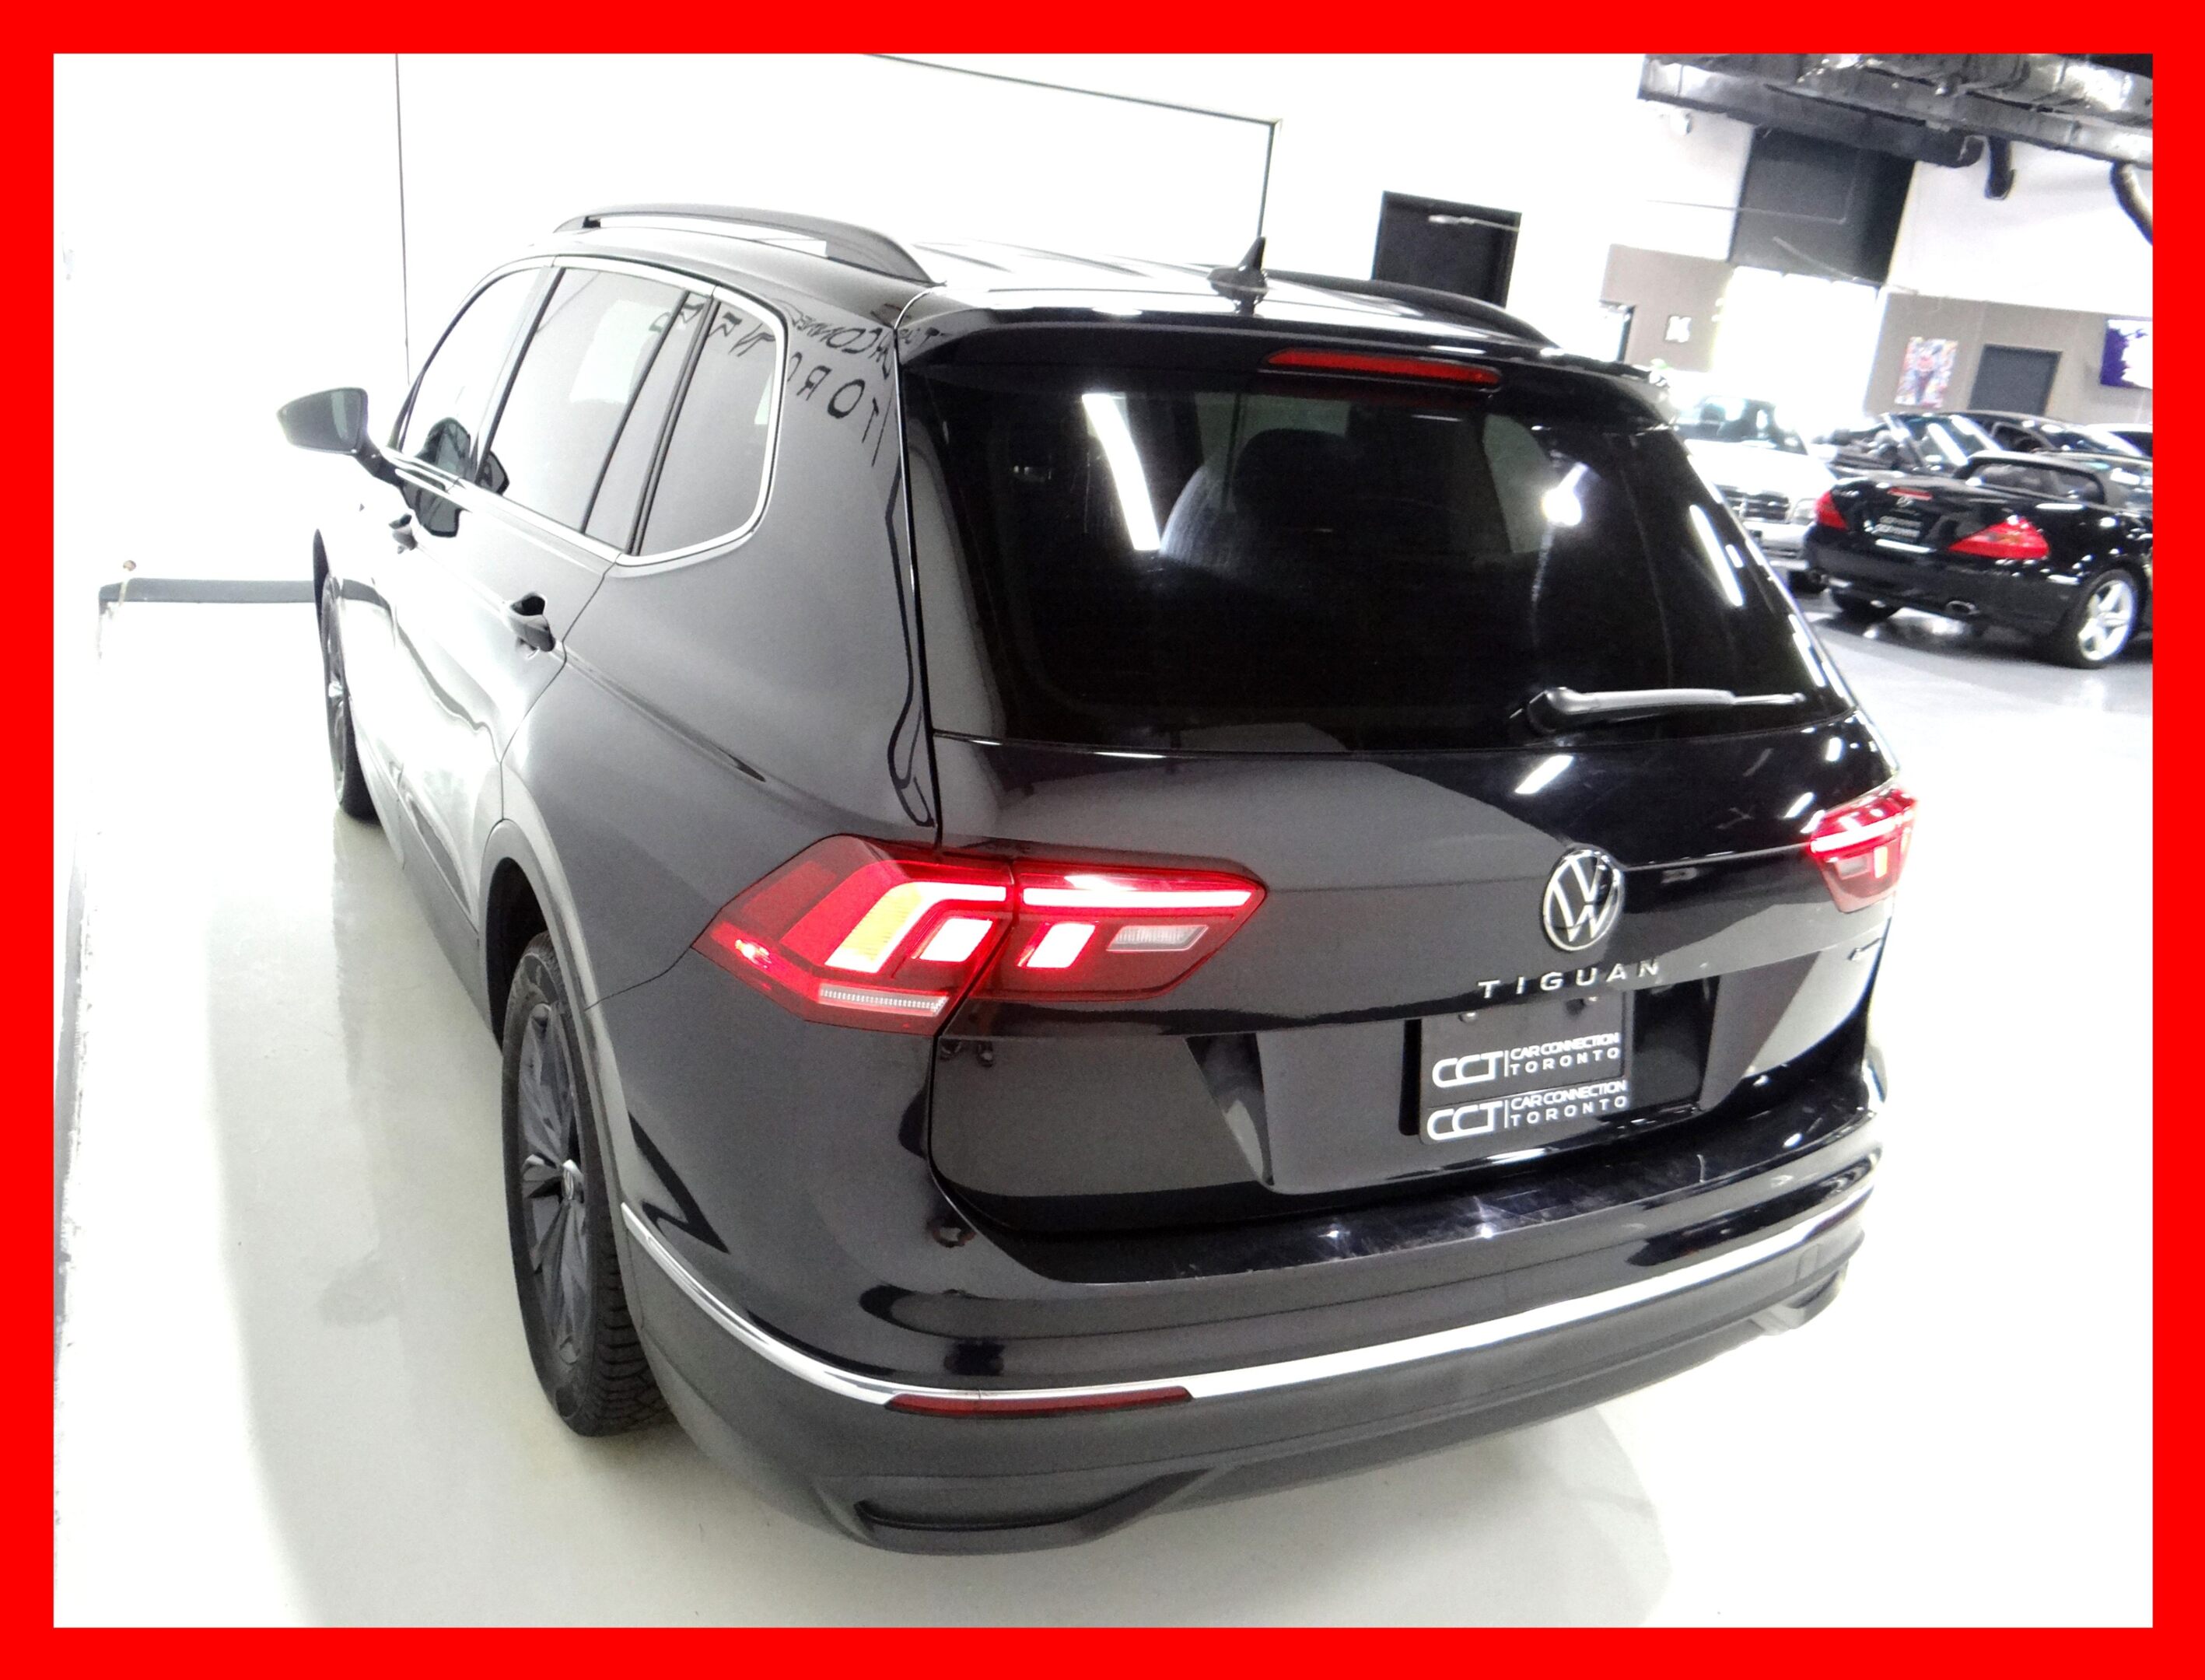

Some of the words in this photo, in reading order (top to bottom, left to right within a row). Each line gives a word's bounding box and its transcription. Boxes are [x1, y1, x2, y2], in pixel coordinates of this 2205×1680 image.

[1478, 961, 1660, 999] TIGUAN
[1510, 1045, 1540, 1060] CAR
[1540, 1032, 1621, 1055] CONNECTION
[1510, 1047, 1621, 1076] TORONTO
[1432, 1050, 1504, 1088] CCT
[1510, 1094, 1543, 1111] CAR
[1543, 1080, 1628, 1108] CONNECTION
[1510, 1095, 1629, 1127] TORONTO
[1426, 1101, 1503, 1141] CCT
